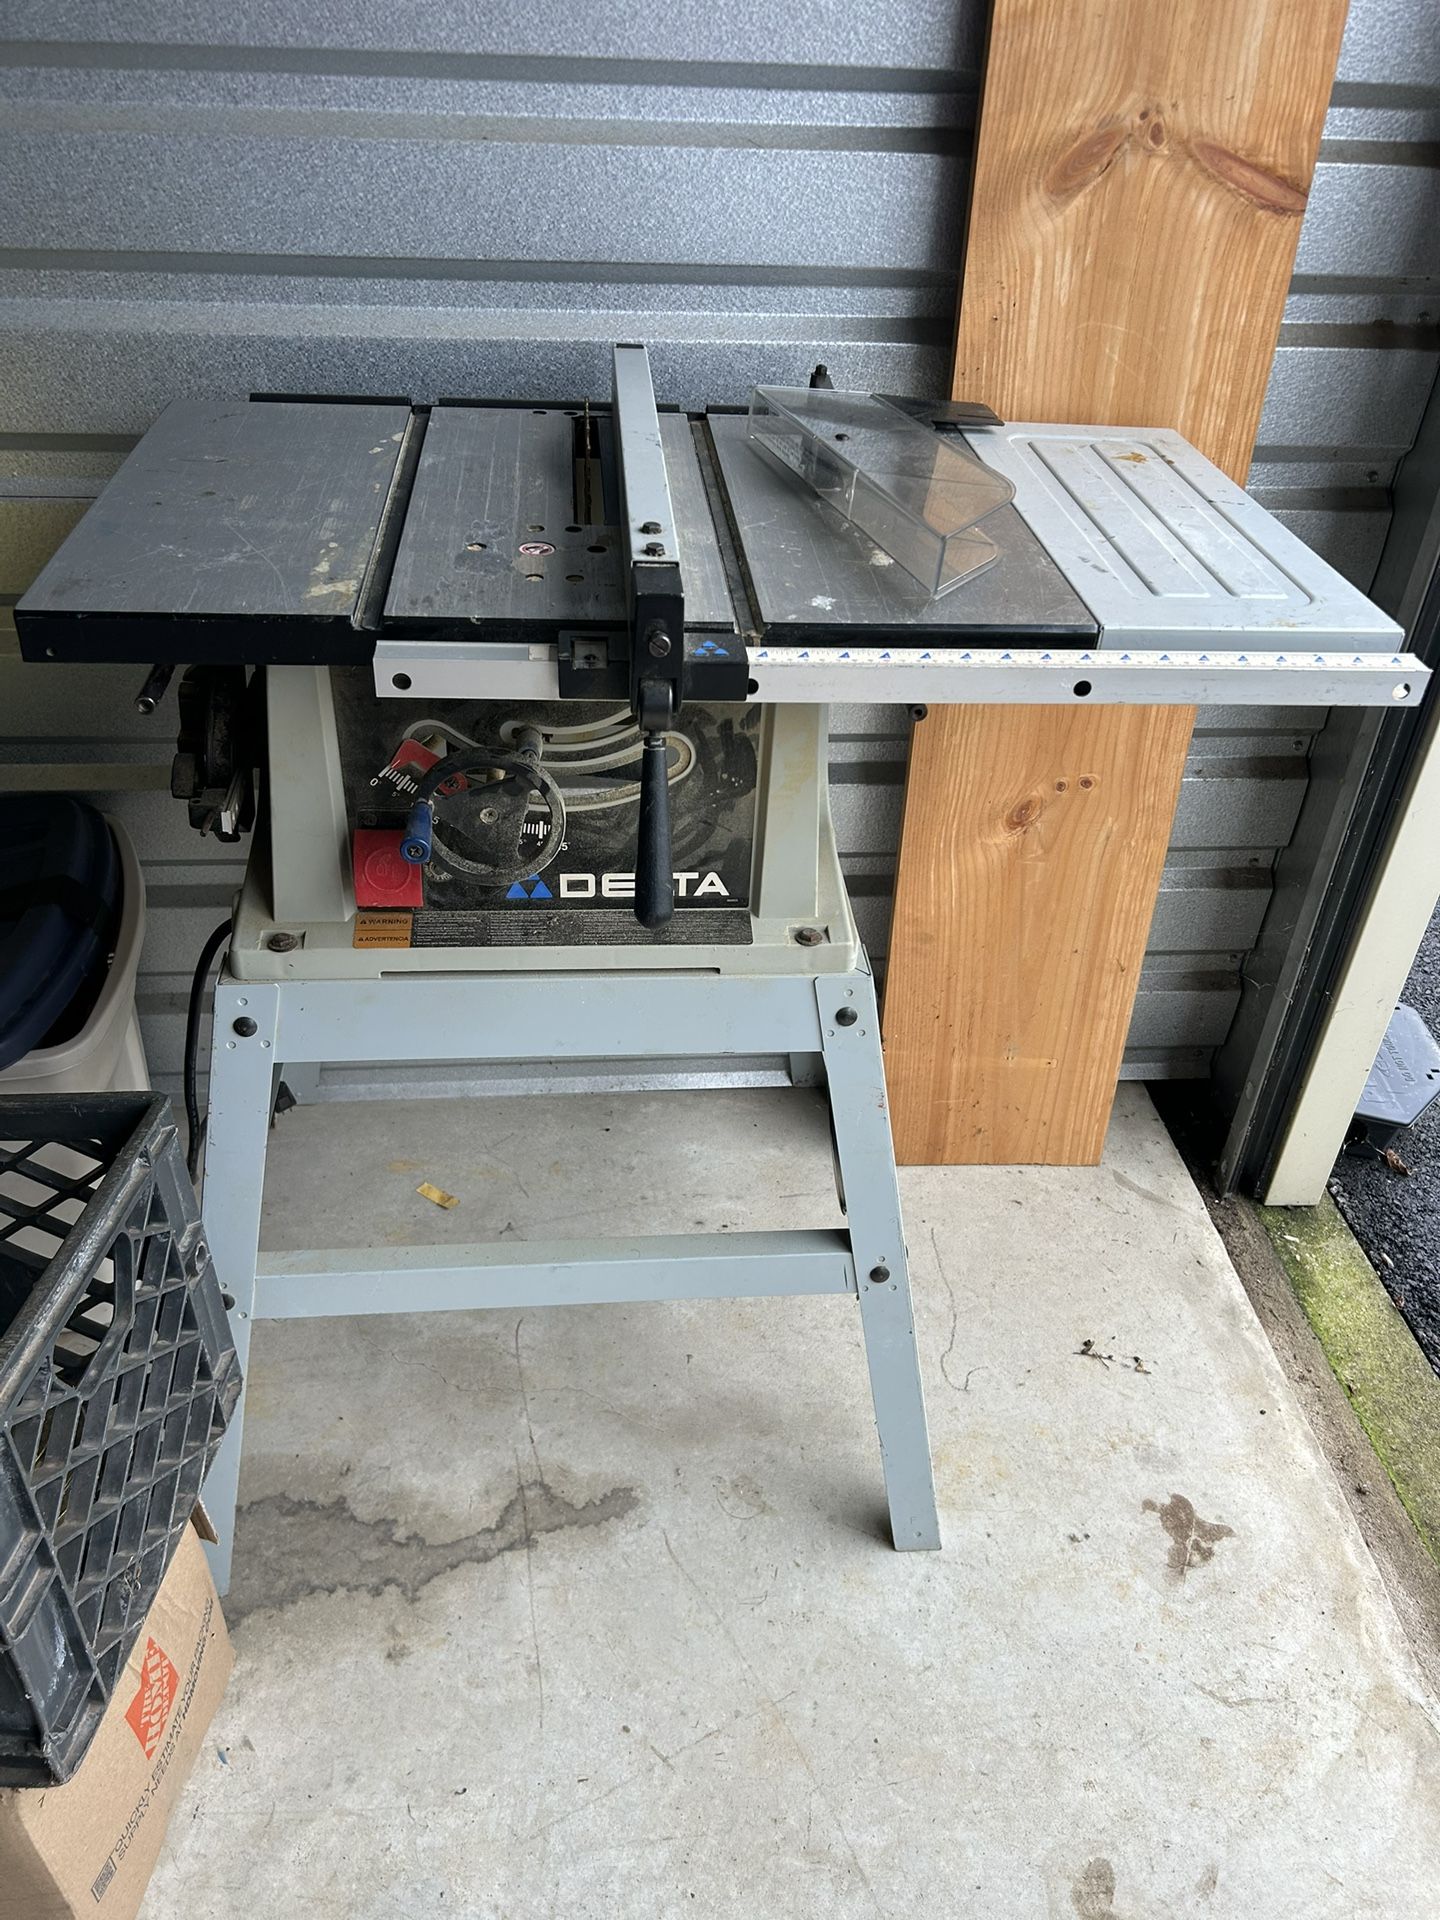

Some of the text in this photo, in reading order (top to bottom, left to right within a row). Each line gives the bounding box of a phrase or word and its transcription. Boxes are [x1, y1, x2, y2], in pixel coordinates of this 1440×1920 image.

[559, 871, 730, 898] DETA
[113, 1781, 150, 1853] QUICKLY
[151, 1704, 182, 1781] ESTIMATE
[118, 1801, 150, 1861] SUPPLY
[151, 1742, 176, 1796] NEEDS
